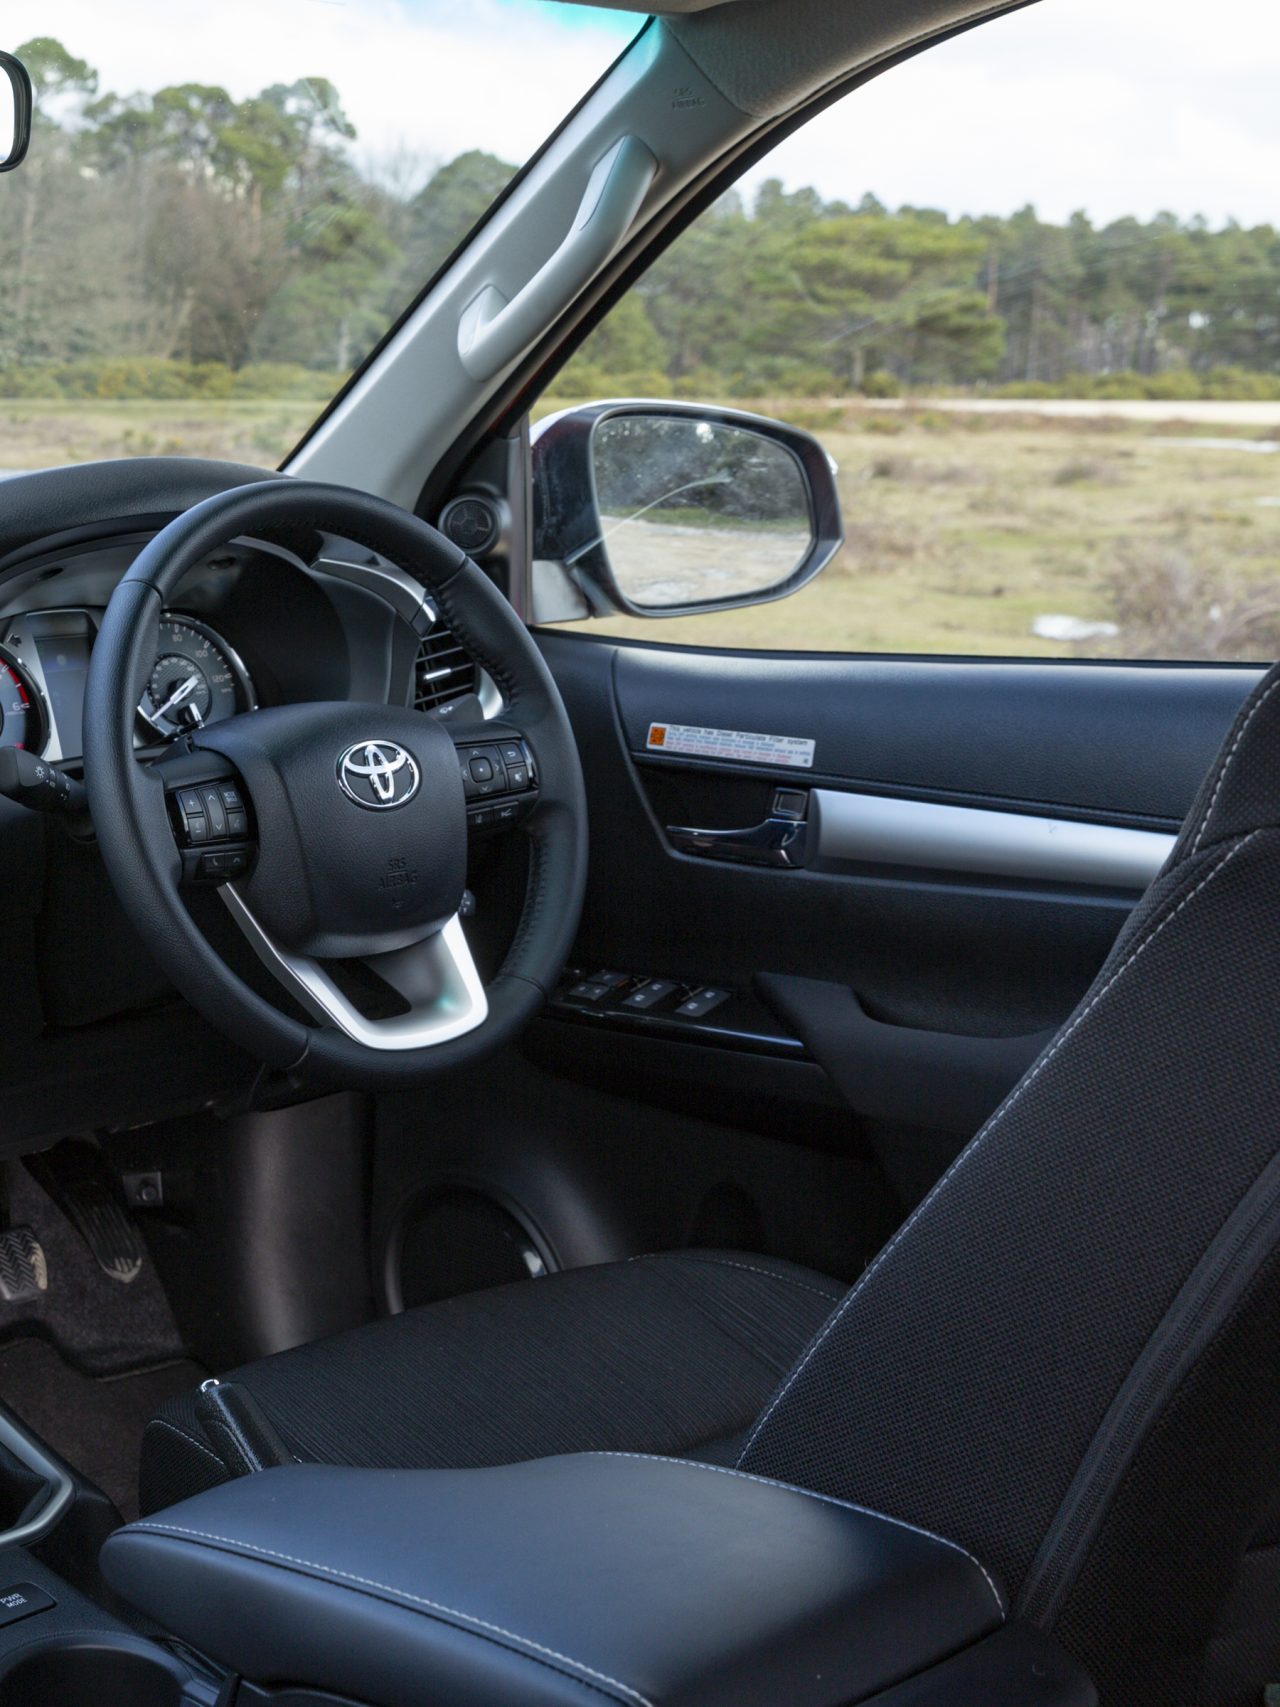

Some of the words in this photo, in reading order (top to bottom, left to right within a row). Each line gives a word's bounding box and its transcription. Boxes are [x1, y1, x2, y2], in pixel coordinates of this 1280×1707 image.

[12, 703, 21, 711] 6
[0, 1593, 22, 1604] PWR
[6, 1597, 28, 1608] MODE
